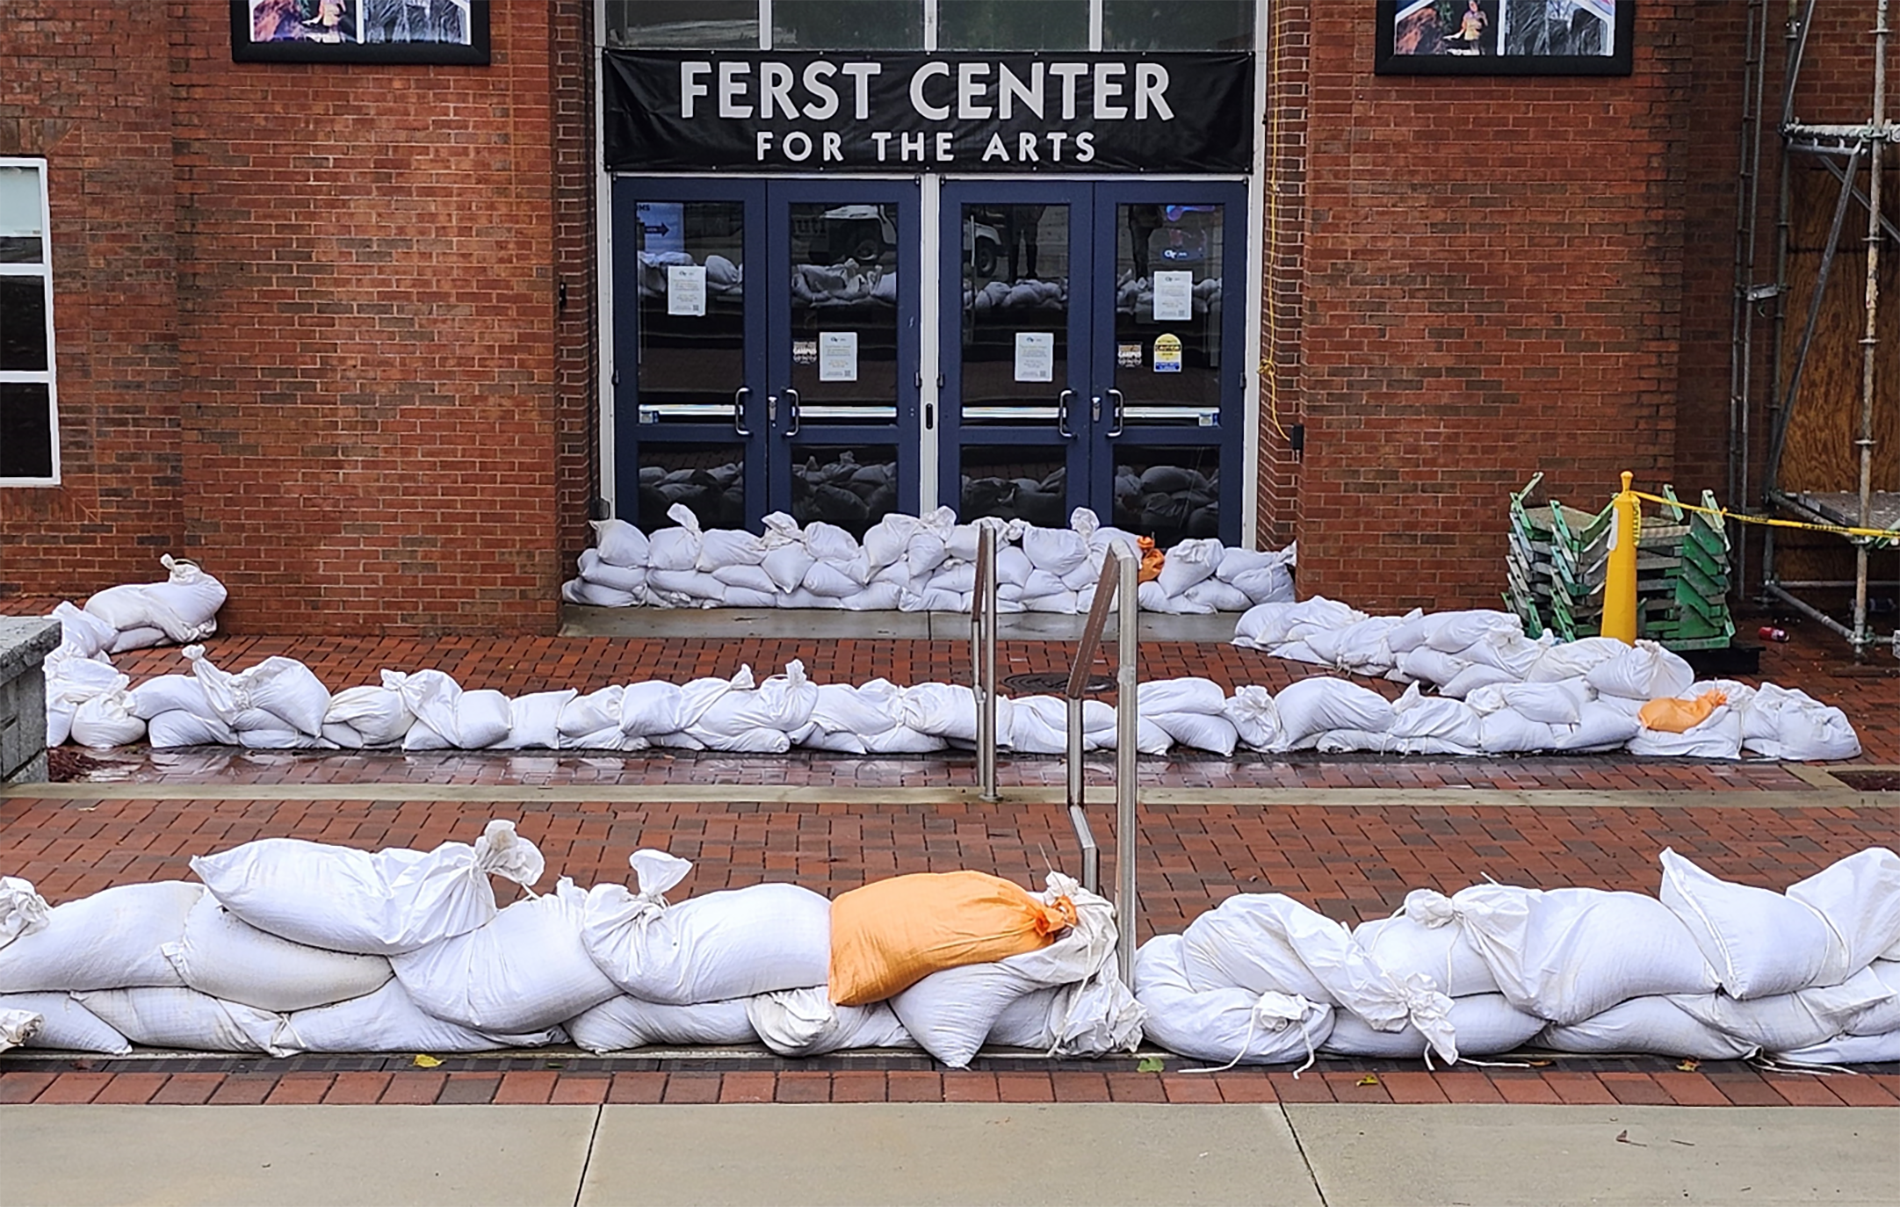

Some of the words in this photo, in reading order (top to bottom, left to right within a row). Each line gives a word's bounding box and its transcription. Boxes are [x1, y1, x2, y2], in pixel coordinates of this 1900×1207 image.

[680, 61, 882, 120] FERST
[909, 61, 1175, 121] CENTER
[757, 131, 844, 162] FOR
[871, 131, 955, 162] THE
[981, 131, 1096, 162] ARTS
